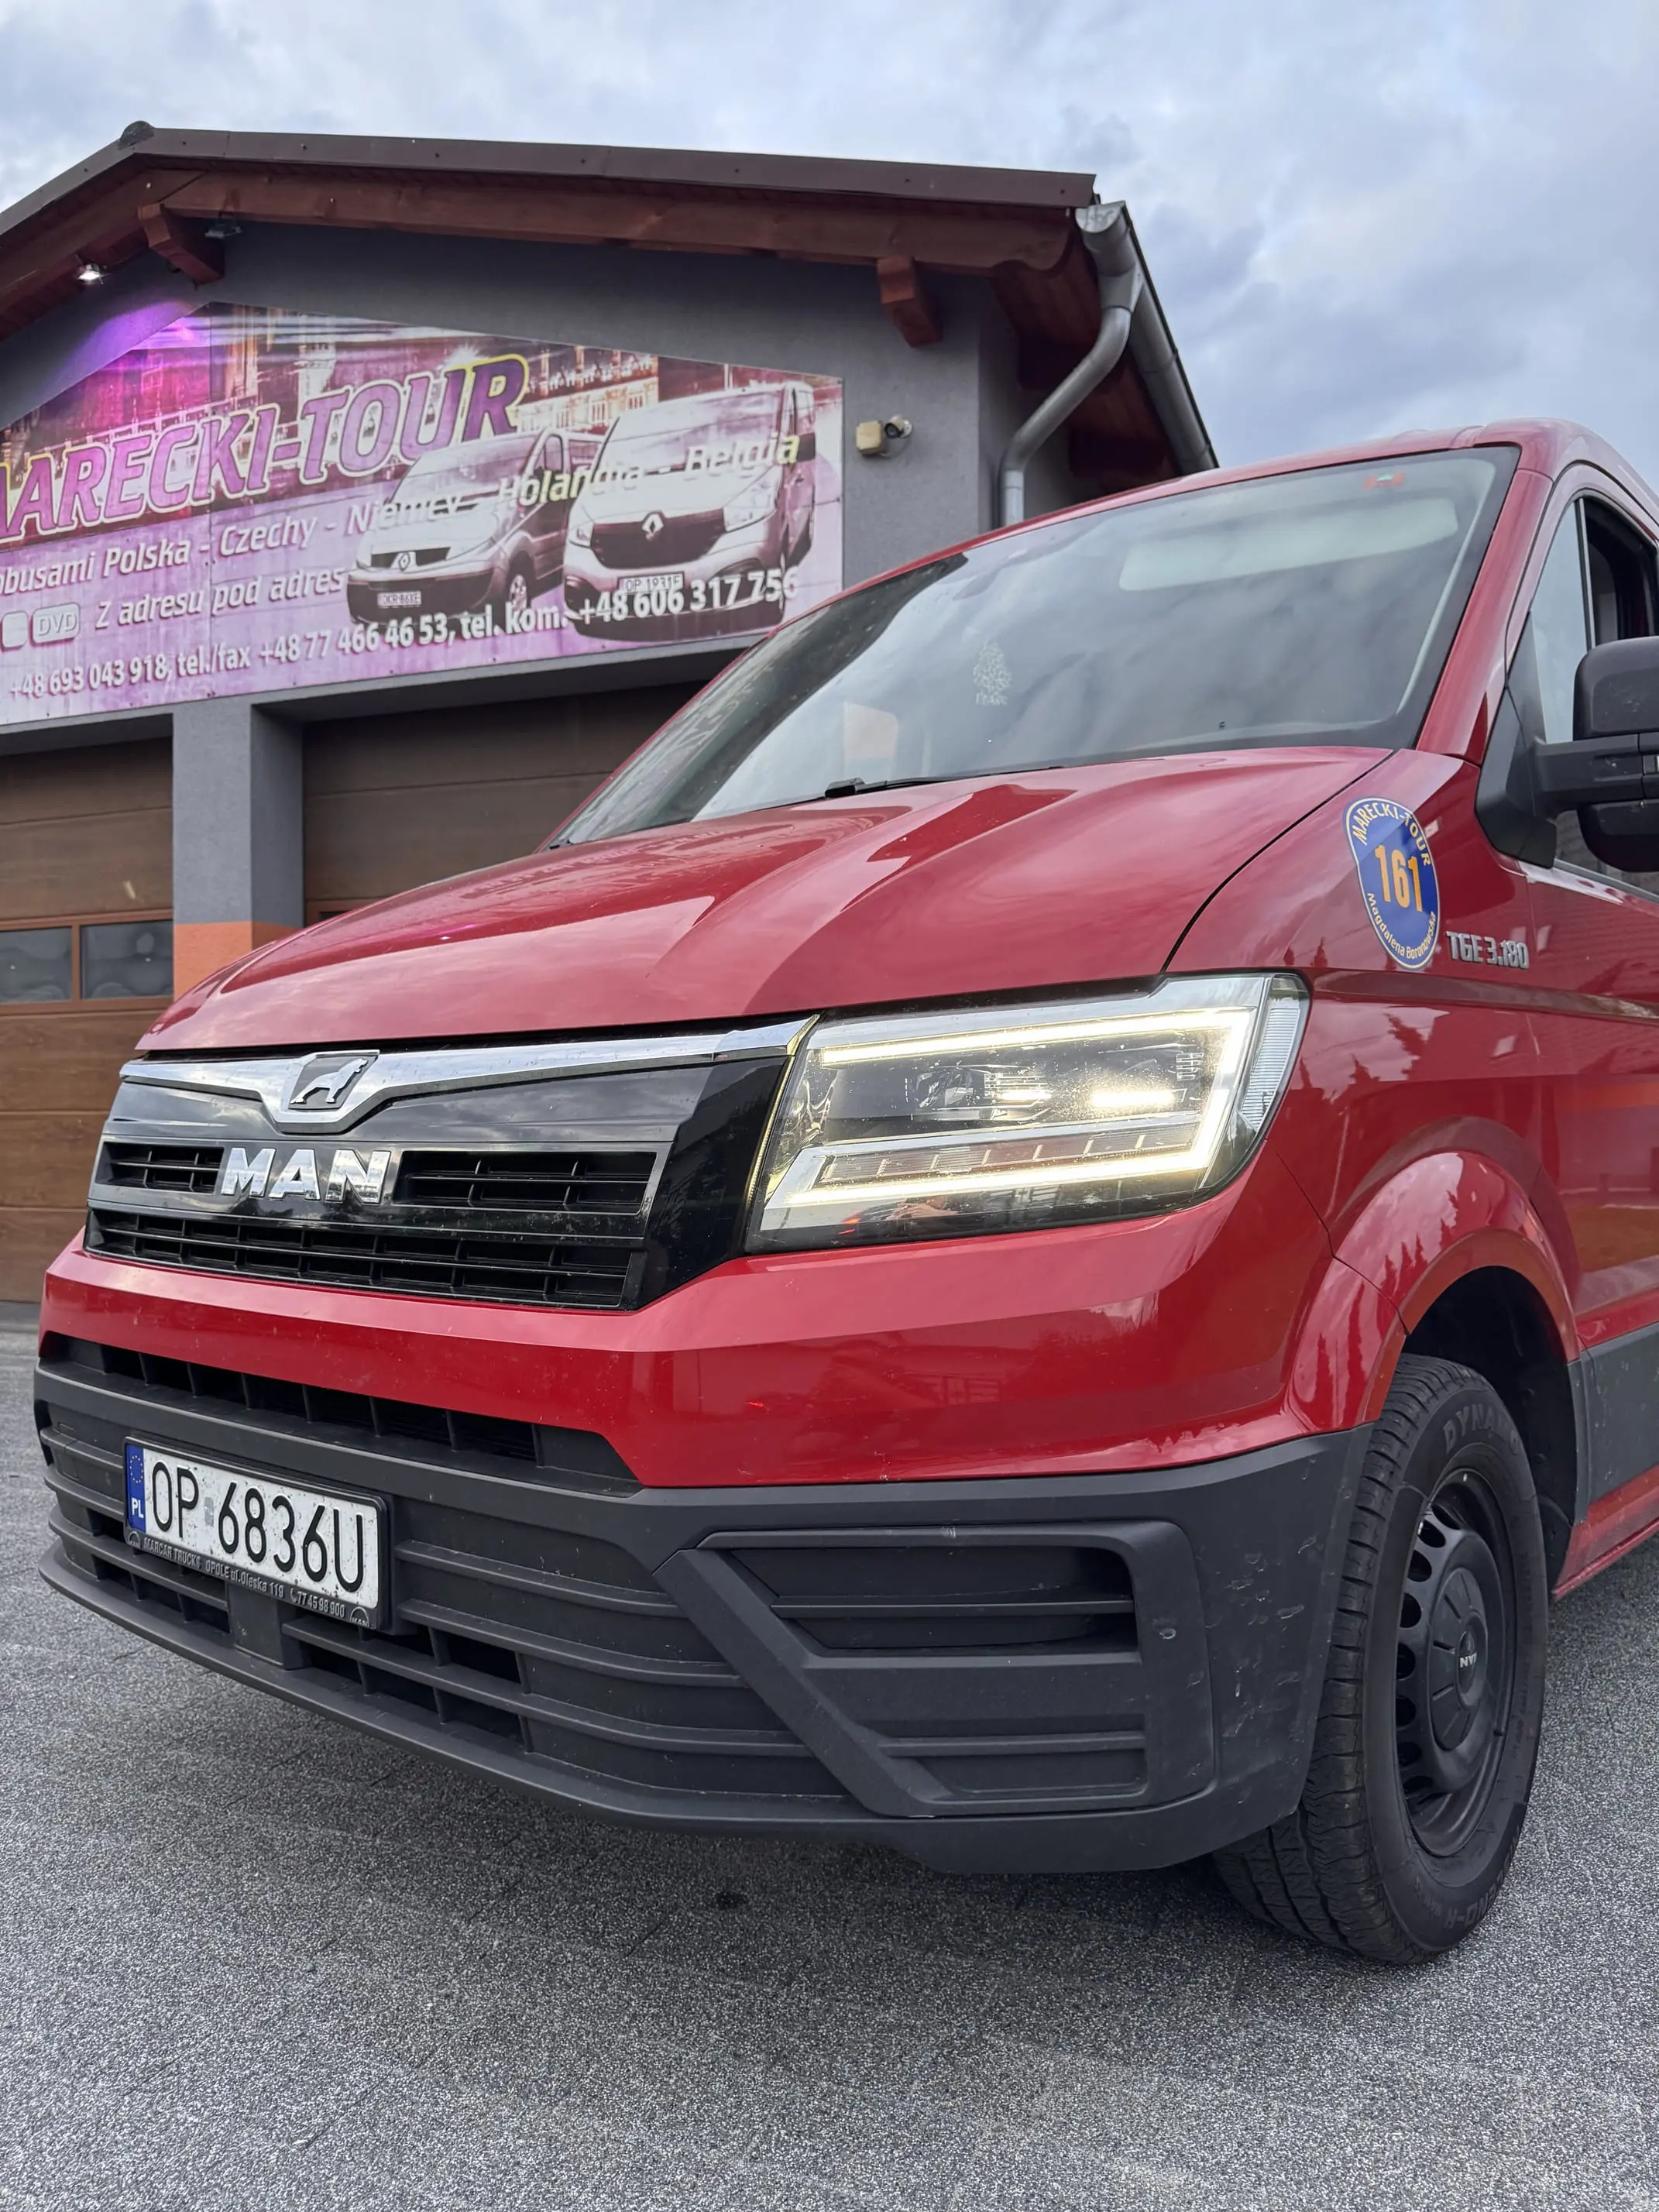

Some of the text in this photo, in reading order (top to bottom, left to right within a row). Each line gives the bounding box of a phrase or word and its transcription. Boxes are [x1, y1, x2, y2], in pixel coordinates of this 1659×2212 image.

[102, 538, 191, 577] Polska
[220, 516, 318, 556] Czechy
[685, 431, 800, 480] Belgia
[39, 610, 77, 636] DVD
[96, 568, 345, 629] Z adresu pod adres
[10, 672, 44, 699] +48
[50, 666, 84, 695] 693
[90, 659, 125, 690] 043
[177, 642, 250, 676] tel./fax
[260, 634, 301, 666] +48
[306, 630, 331, 658] 77
[339, 623, 380, 654] 466
[385, 617, 414, 648] 46
[419, 613, 456, 645] 53,
[459, 604, 500, 640] tel.
[505, 601, 568, 635] kom.
[579, 590, 628, 625] +48
[634, 586, 685, 618] 606
[690, 575, 742, 611] 317
[747, 566, 801, 603] 756
[1352, 802, 1431, 867] MARECKI-TOUR
[1374, 845, 1423, 912] 161
[1367, 893, 1405, 957] Magdalena
[1445, 930, 1529, 969] TGE 3.180
[221, 1147, 392, 1204] MAN
[132, 1497, 144, 1519] PL
[152, 1461, 364, 1593] OP 6836U
[143, 1537, 173, 1560] MARCAR
[173, 1547, 201, 1569] TRUCKS
[205, 1559, 230, 1579] OPOLE
[270, 1582, 285, 1599] 119
[307, 1594, 318, 1610] 45
[330, 1600, 345, 1619] 900
